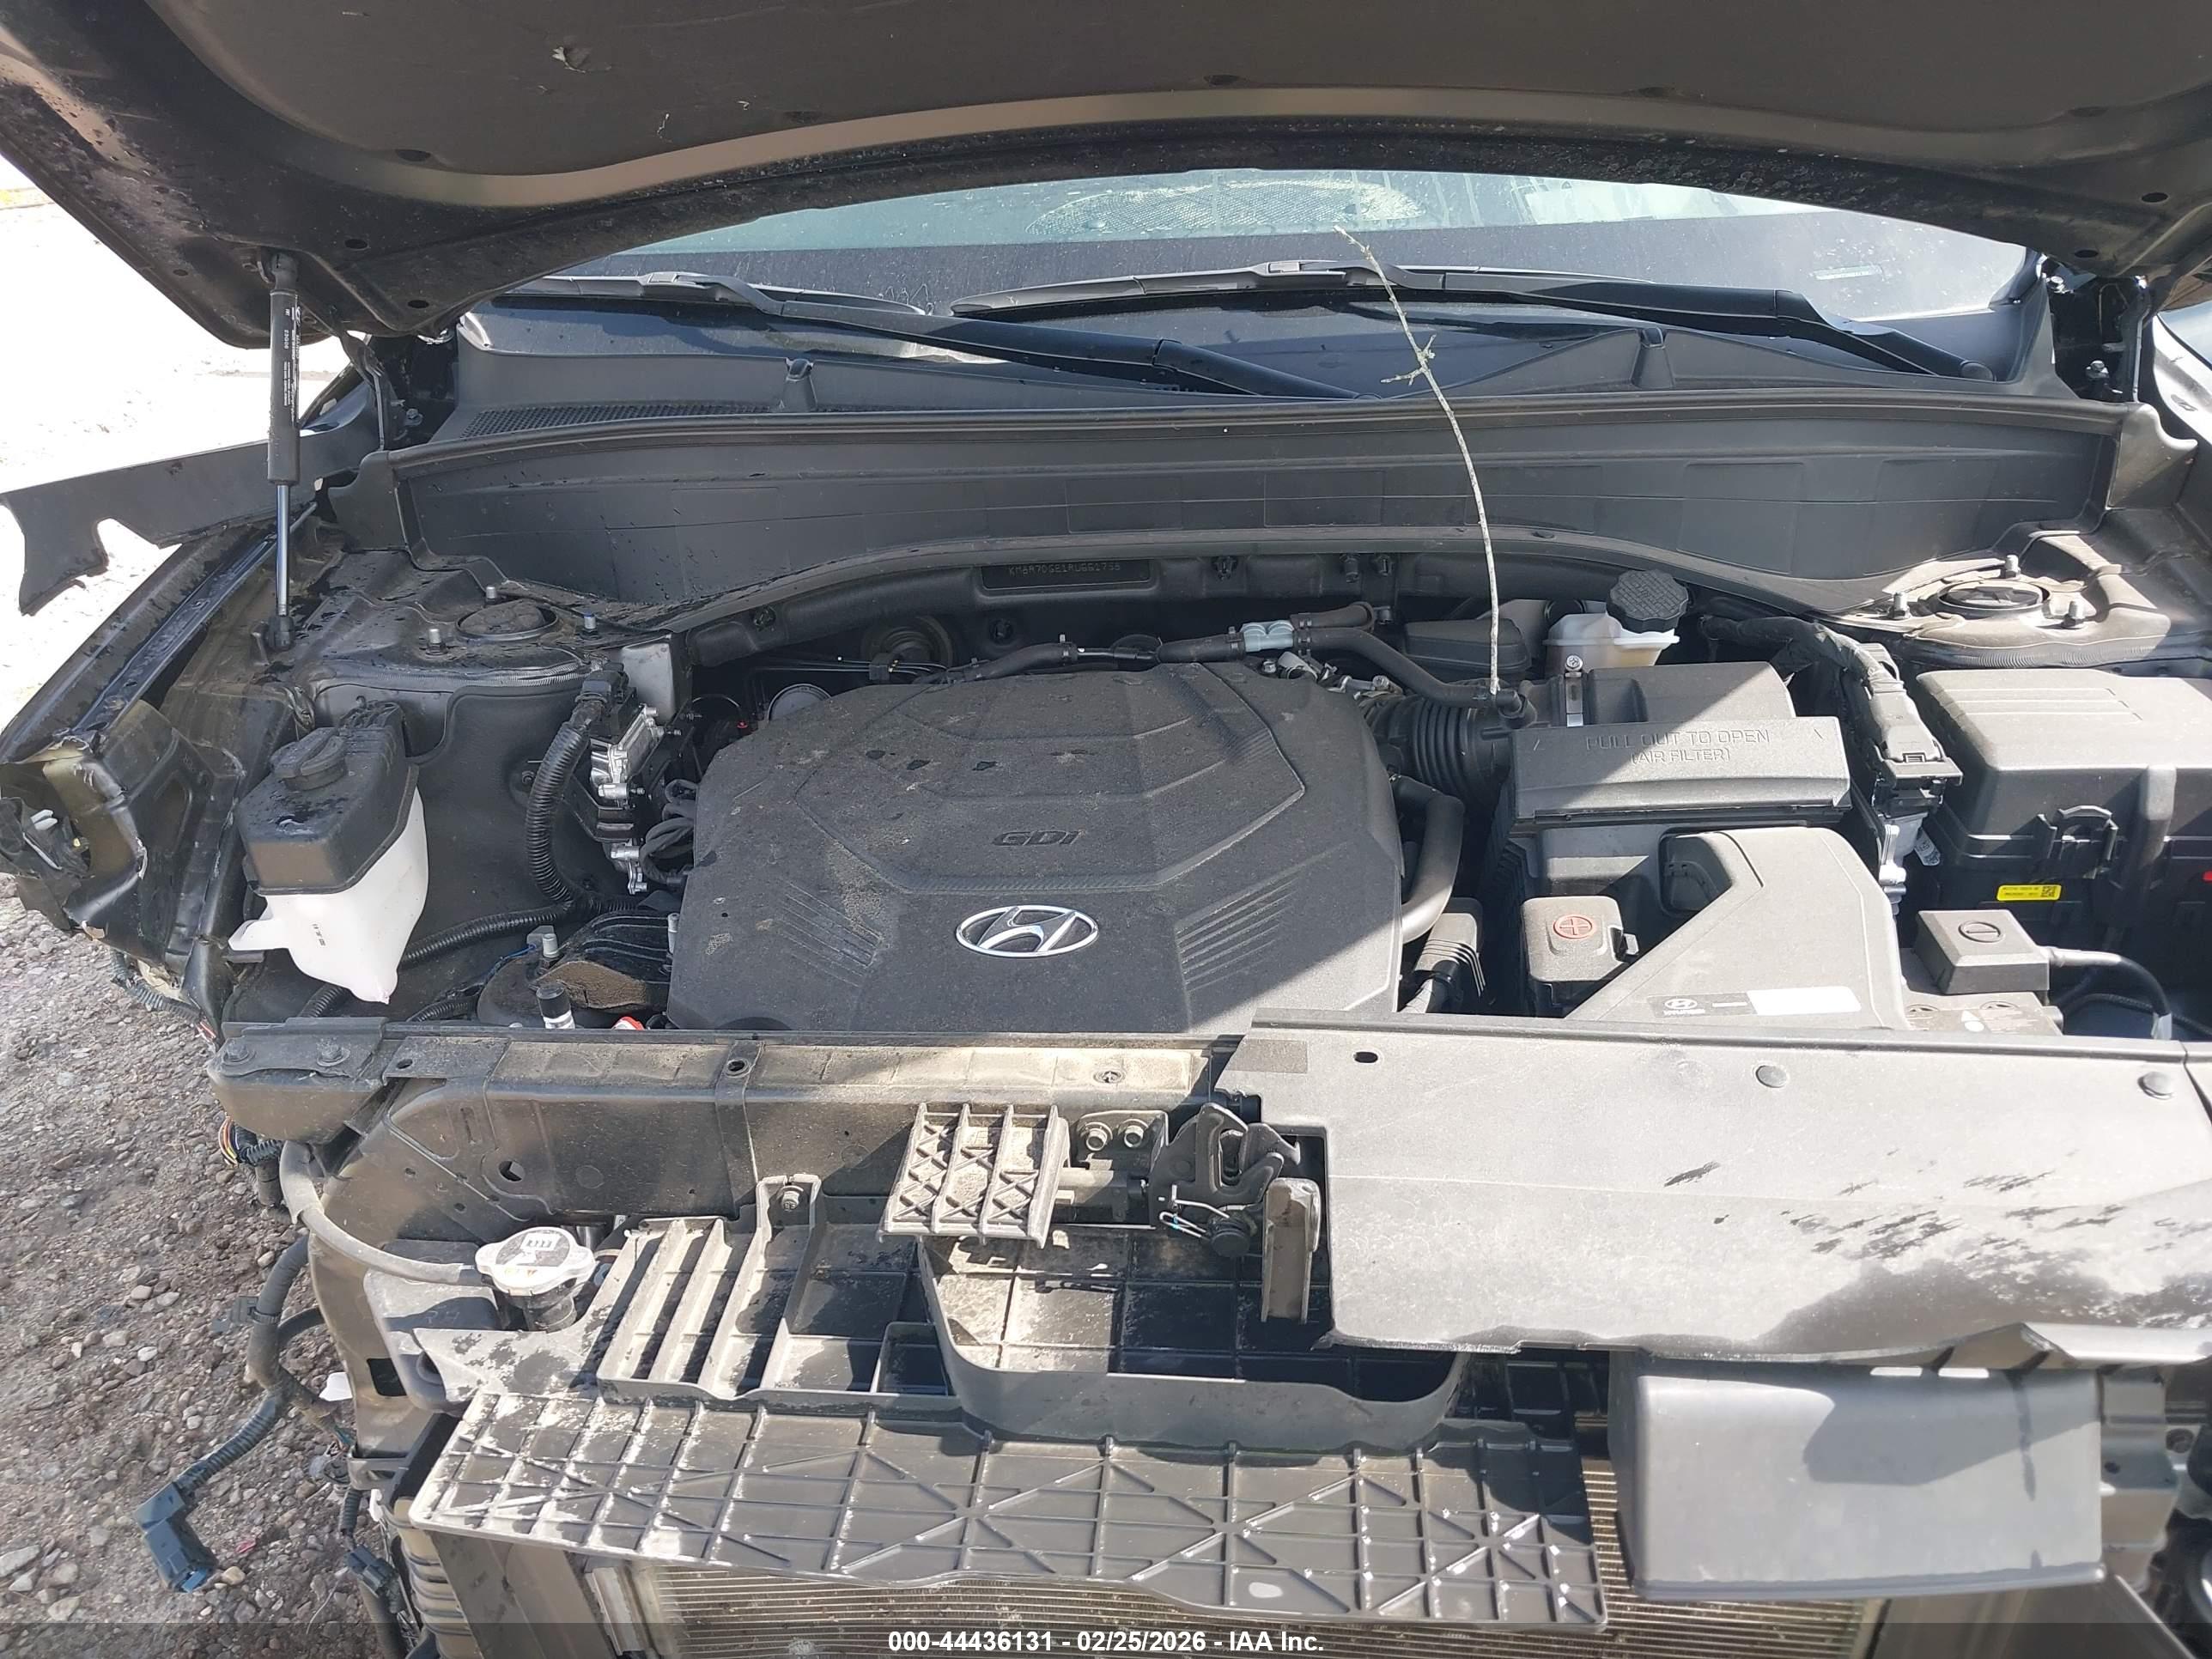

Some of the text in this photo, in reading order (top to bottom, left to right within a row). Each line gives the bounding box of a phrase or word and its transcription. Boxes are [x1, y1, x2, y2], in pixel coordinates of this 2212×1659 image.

[1586, 729, 1770, 750] PULL OUT TO OPEN
[1631, 746, 1731, 765] (AIR FILTER)
